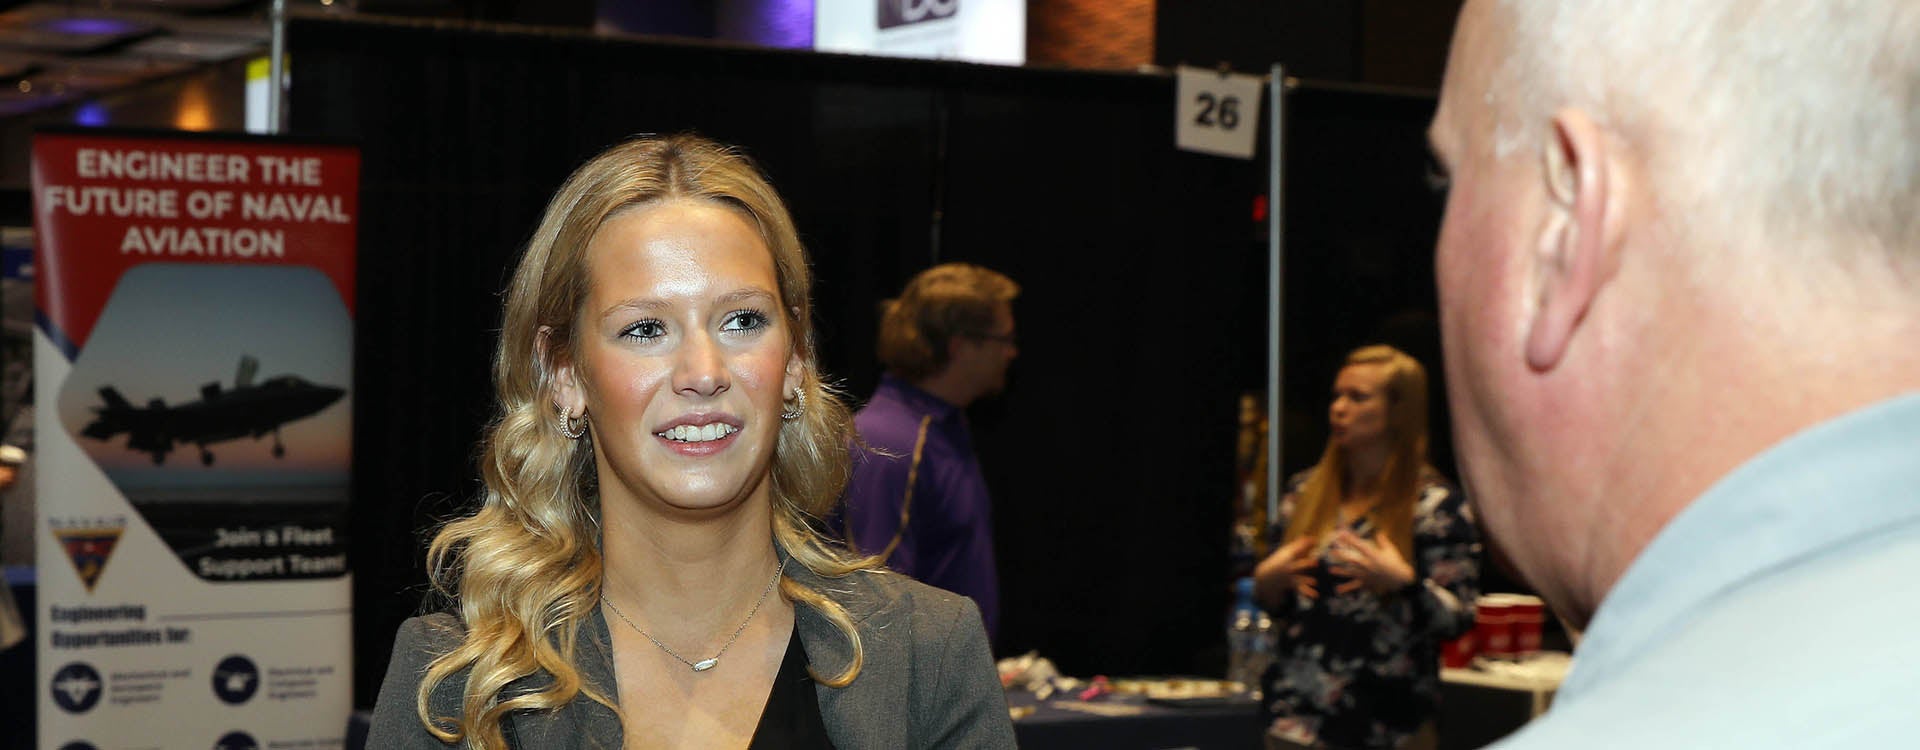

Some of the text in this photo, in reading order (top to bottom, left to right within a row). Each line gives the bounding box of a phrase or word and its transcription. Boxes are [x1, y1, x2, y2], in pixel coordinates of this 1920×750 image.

[1194, 91, 1242, 131] 26
[77, 149, 322, 186] ENGINEER THE
[45, 187, 350, 223] FUTURE OF NAVAL
[121, 227, 285, 257] AVIATION
[215, 527, 334, 547] Join a Fleet
[199, 556, 284, 578] Support
[50, 604, 146, 622] Engineering
